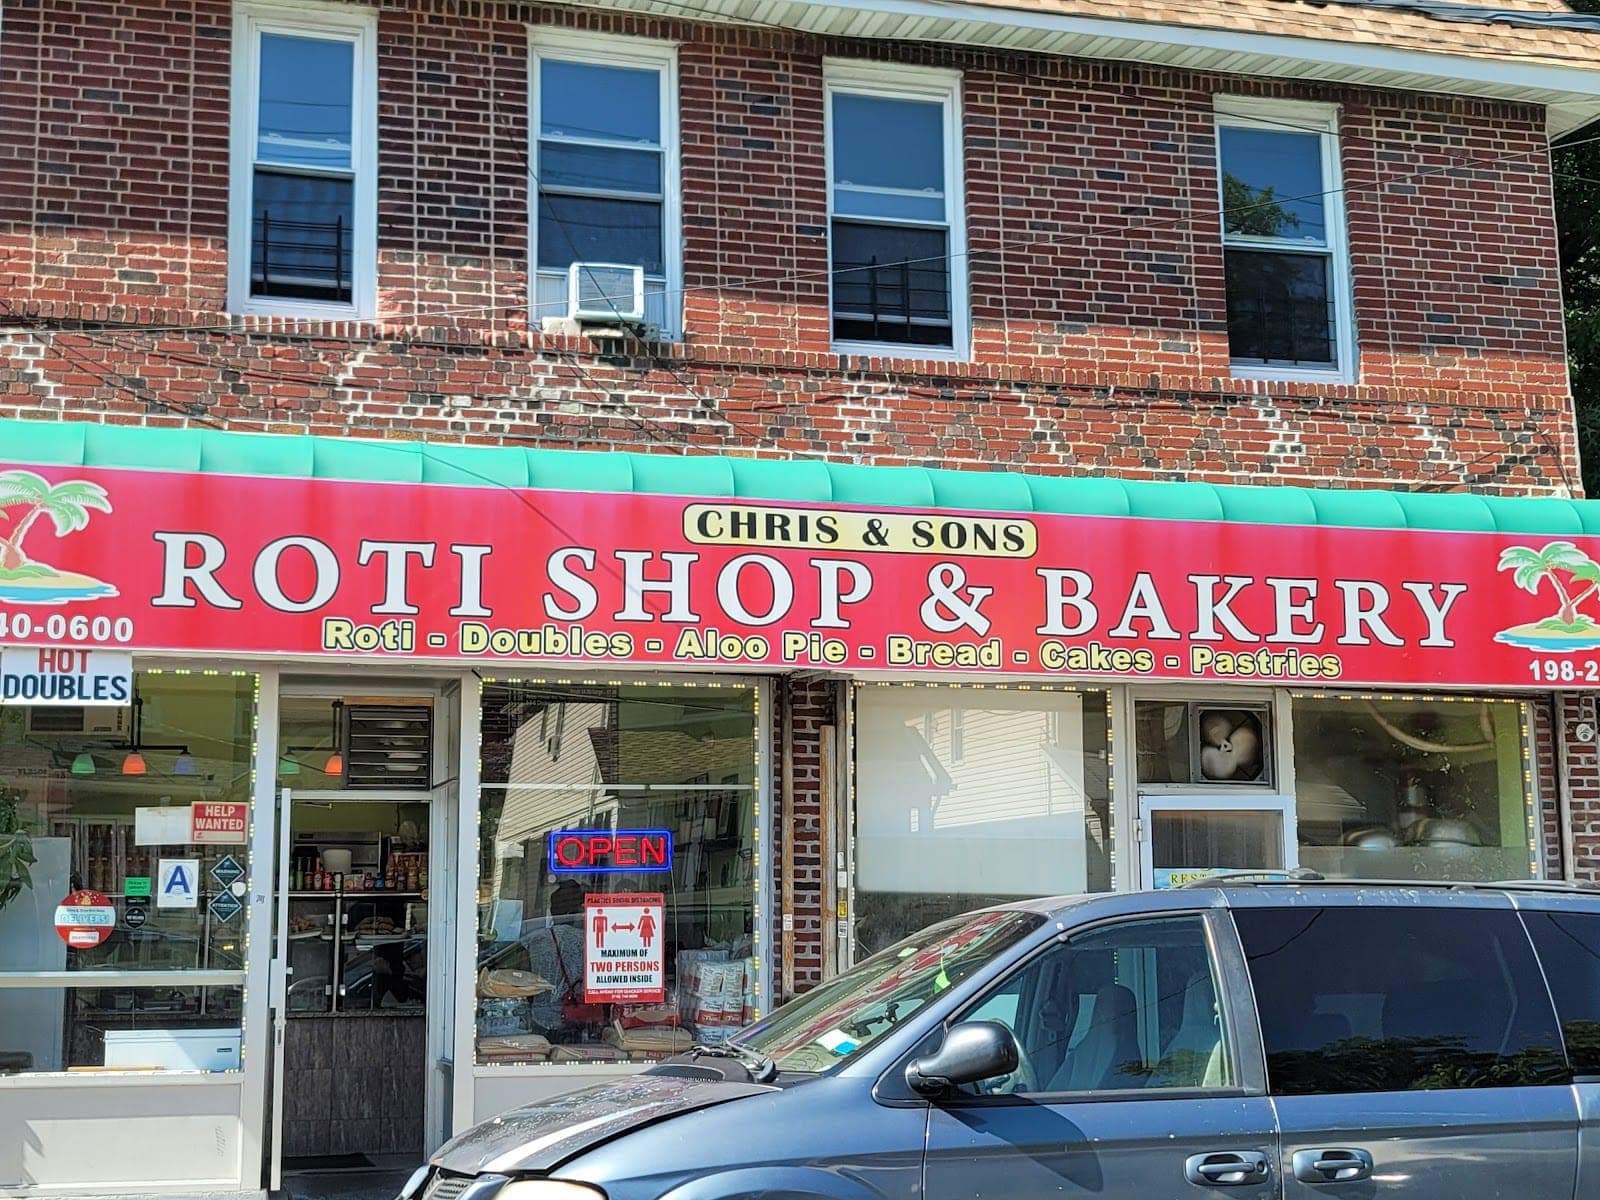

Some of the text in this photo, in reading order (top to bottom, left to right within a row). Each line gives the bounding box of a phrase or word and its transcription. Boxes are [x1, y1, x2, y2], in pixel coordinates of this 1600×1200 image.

[697, 510, 1025, 552] CHRIS & SONS
[151, 531, 1468, 648] ROTI SHOP & BAKERY
[38, 647, 92, 673] HOT
[324, 618, 415, 650] Roti
[461, 623, 633, 657] Doubles
[675, 629, 769, 660] Aloo
[783, 632, 847, 661] Pie
[888, 636, 1001, 667] Bread
[1040, 641, 1153, 672] Cakes
[1191, 646, 1341, 678] Pastries
[1529, 659, 1600, 682] 198-2
[3, 674, 128, 700] DOUBLES
[195, 818, 244, 830] WANTED
[204, 805, 236, 817] HELP
[556, 836, 666, 867] OPEN
[164, 865, 191, 894] A
[601, 949, 648, 958] MAXIMUM OF
[591, 961, 660, 973] TWO PERSONS
[596, 974, 653, 984] ALLOWED INSIDE
